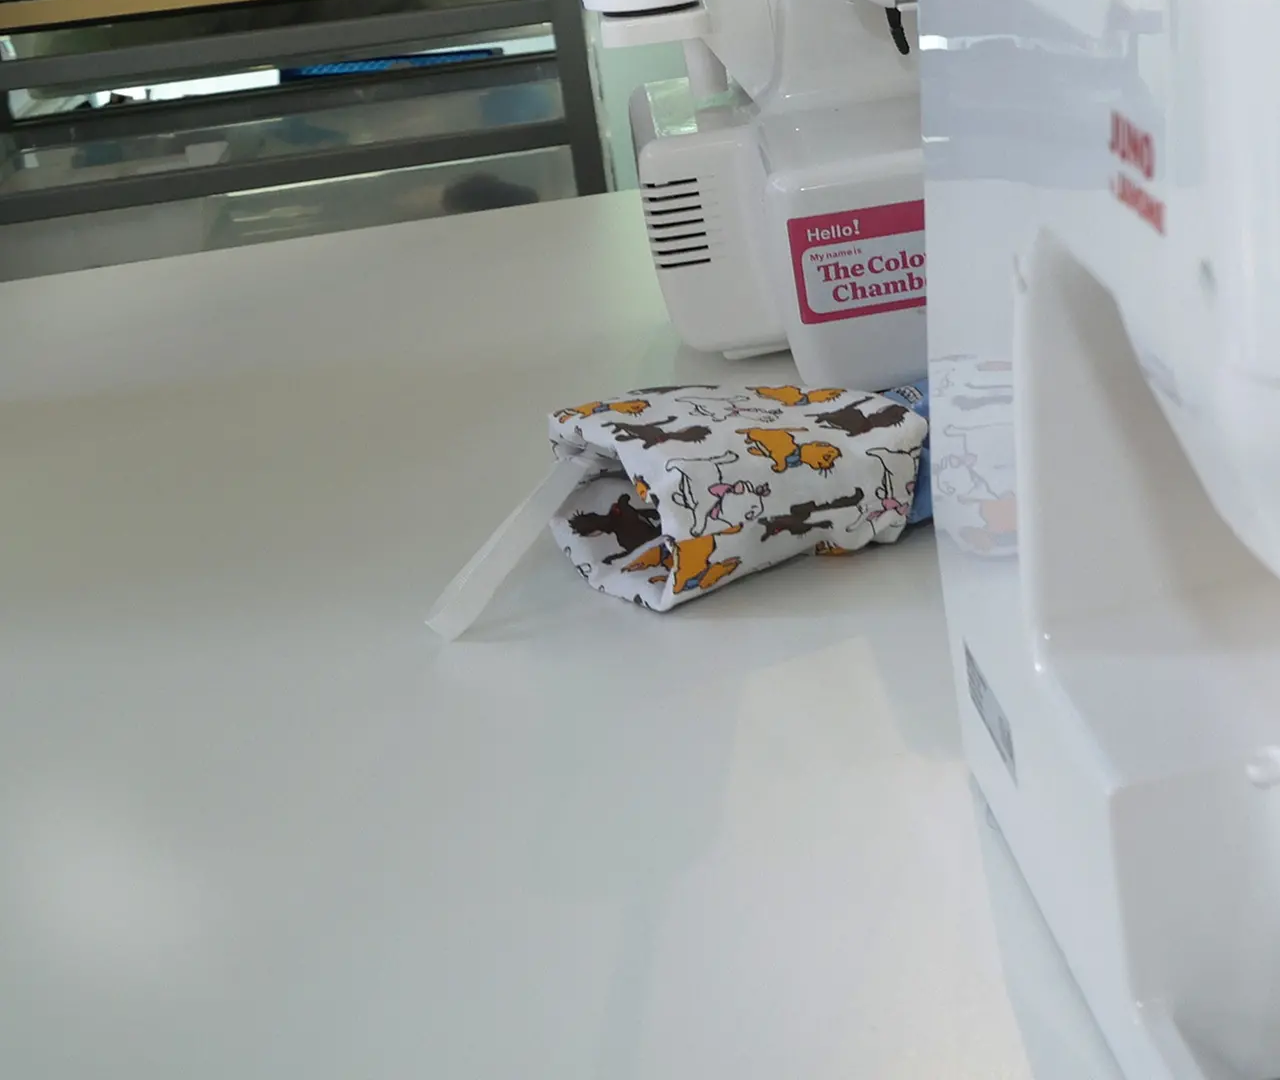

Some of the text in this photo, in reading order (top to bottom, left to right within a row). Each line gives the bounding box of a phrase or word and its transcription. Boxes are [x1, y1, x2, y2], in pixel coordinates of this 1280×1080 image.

[806, 219, 861, 242] Hello!
[810, 246, 862, 262] My name is
[817, 250, 927, 282] The Colo
[832, 272, 927, 302] Chamb
